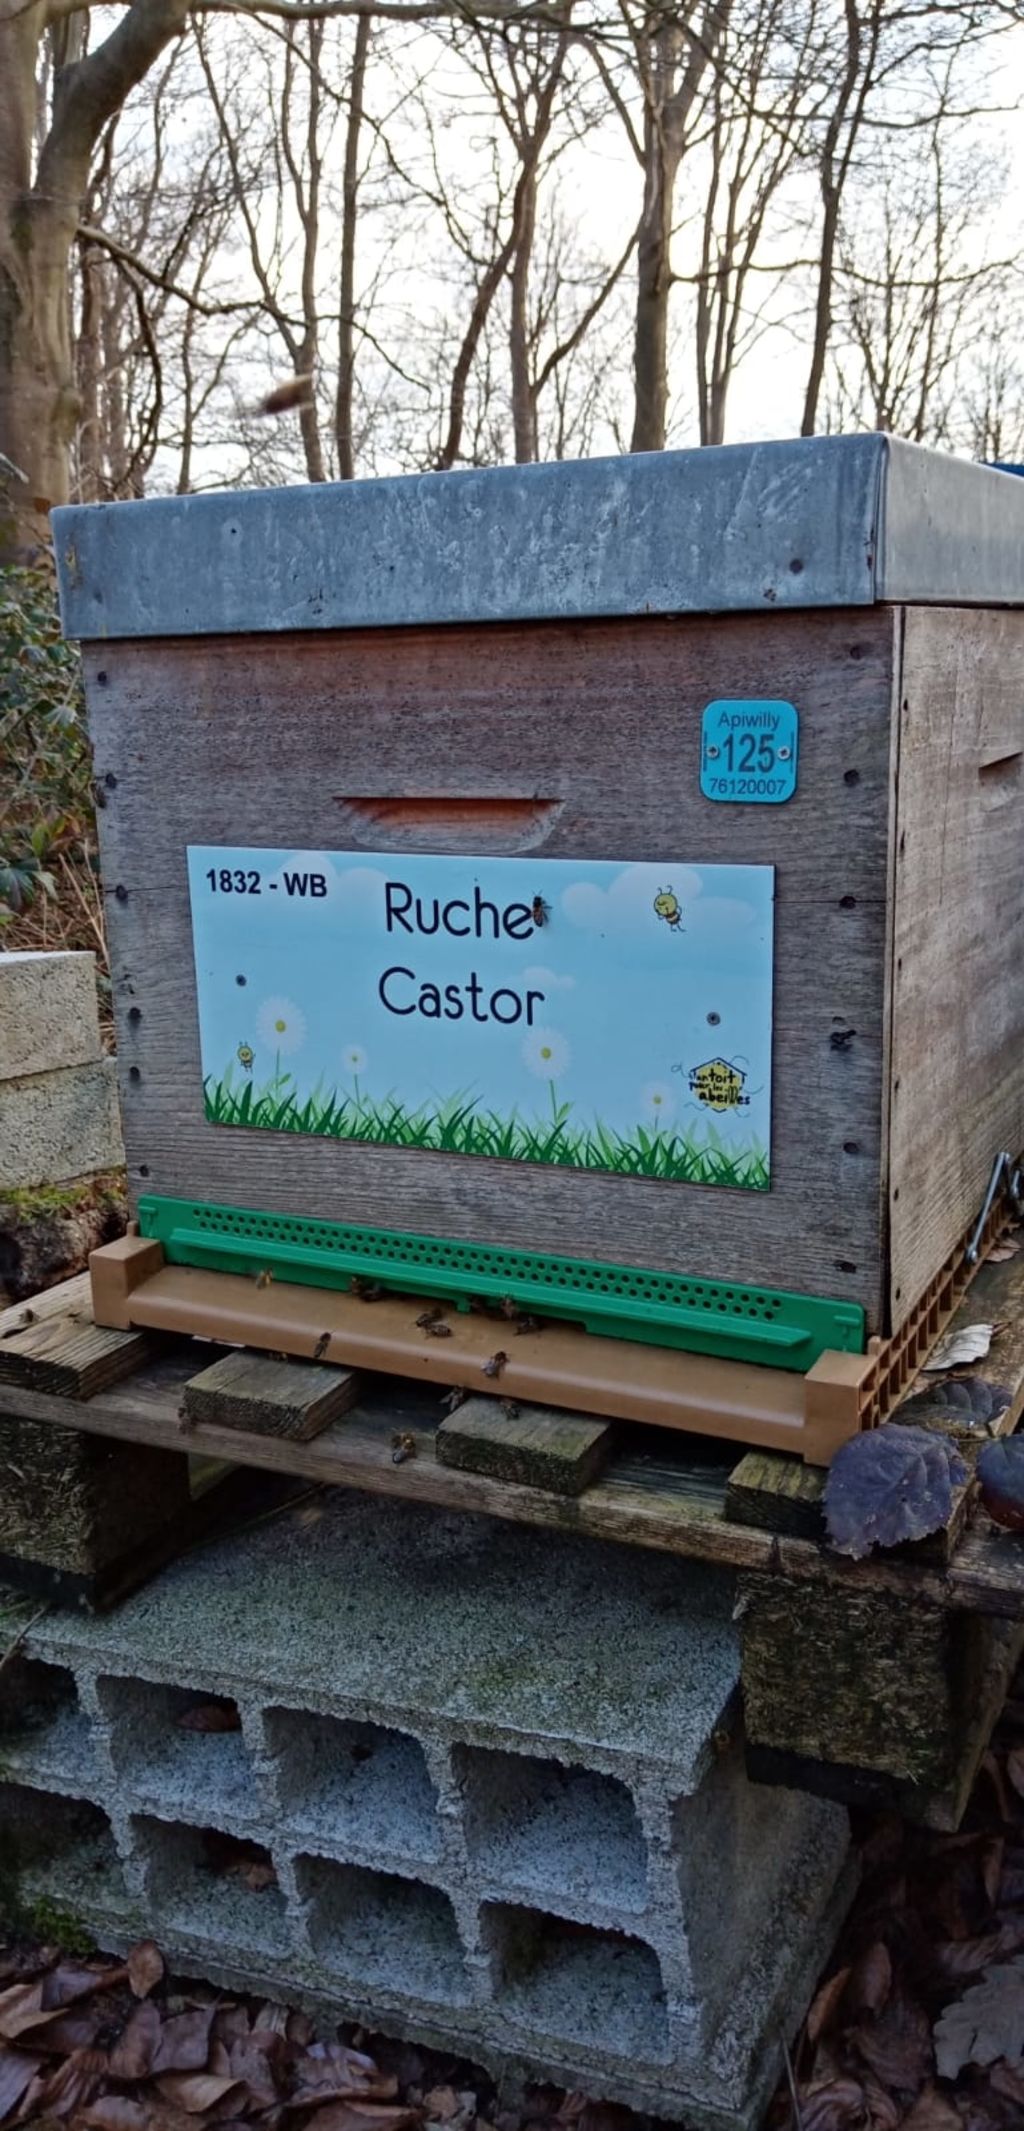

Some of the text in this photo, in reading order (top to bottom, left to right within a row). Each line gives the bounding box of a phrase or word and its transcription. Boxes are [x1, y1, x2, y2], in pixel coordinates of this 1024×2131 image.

[718, 711, 780, 731] Apiwilly
[723, 733, 775, 773] 125
[709, 778, 786, 795] 76120007
[206, 869, 261, 894] 1832
[283, 872, 327, 897] WB
[385, 882, 534, 940] Ruche
[379, 966, 545, 1026] Castor
[699, 1086, 751, 1105] abeilles
